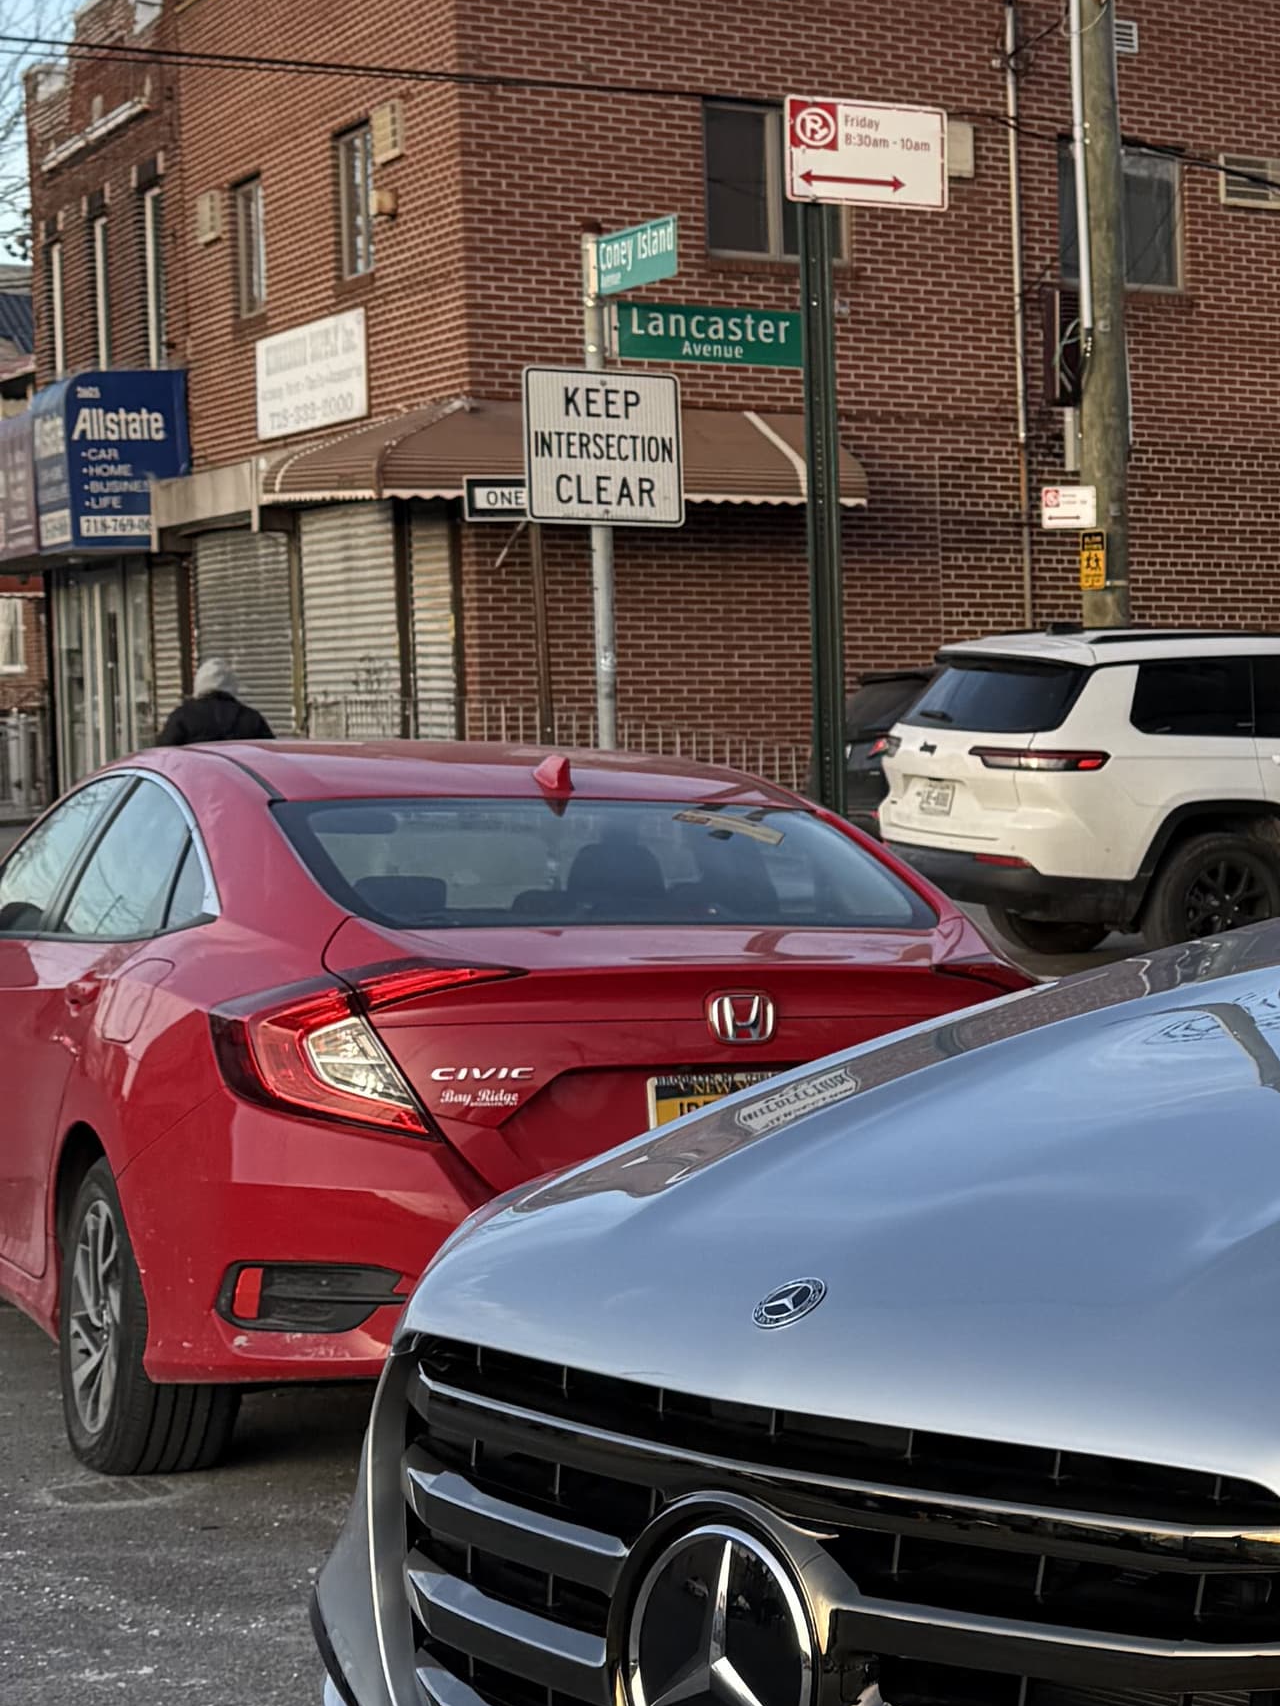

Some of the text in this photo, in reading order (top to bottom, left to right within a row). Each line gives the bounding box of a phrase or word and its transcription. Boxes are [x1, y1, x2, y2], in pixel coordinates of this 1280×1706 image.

[844, 113, 880, 131] Friday
[844, 135, 889, 149] 8:30am
[901, 138, 931, 152] 10am
[599, 222, 674, 272] Coney Island
[631, 306, 791, 344] Lancaster
[682, 340, 744, 359] Avenue
[564, 386, 641, 421] KEEP
[71, 407, 167, 441] Allstate
[88, 448, 120, 461] CAR
[534, 430, 674, 464] INTERSECTION
[88, 464, 134, 477] HOME
[486, 490, 524, 507] ONE
[555, 473, 657, 508] CLEAR
[91, 496, 123, 509] LIFE
[431, 1066, 535, 1081] CIVIC
[439, 1088, 519, 1106] Bay Ridge
